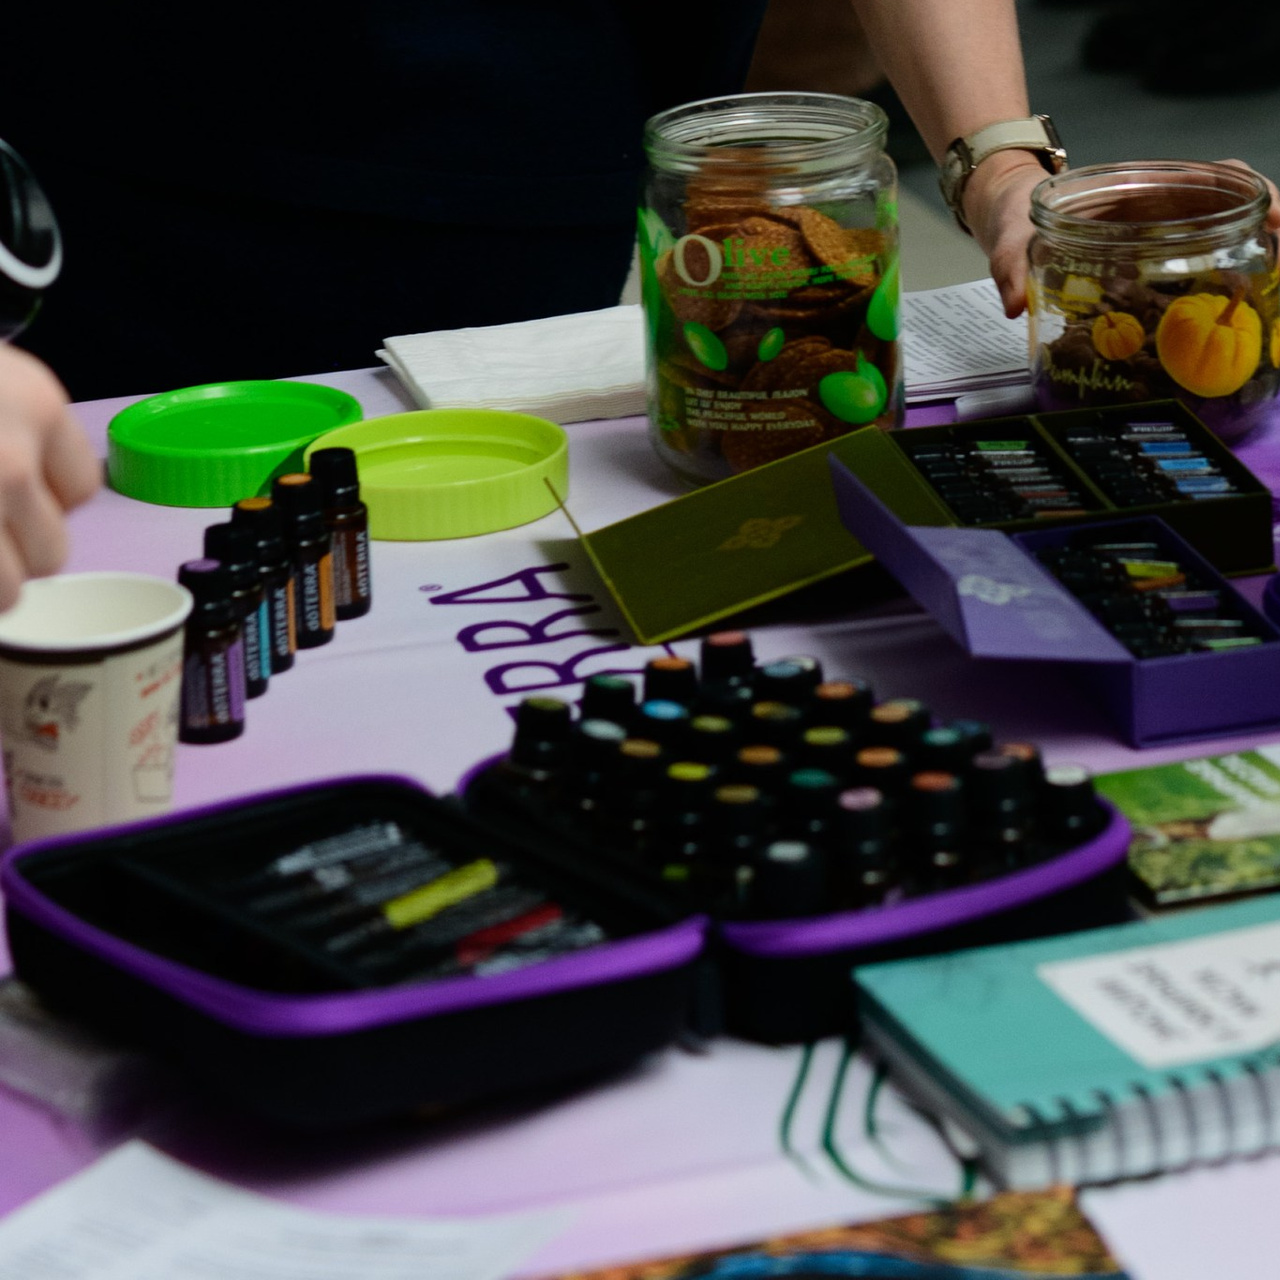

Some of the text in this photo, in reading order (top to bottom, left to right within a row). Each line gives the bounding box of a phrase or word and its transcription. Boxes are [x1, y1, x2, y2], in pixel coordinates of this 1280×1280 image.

[673, 234, 790, 287] Olive
[1042, 343, 1134, 400] Pumpkin
[731, 422, 763, 431] HAPPY
